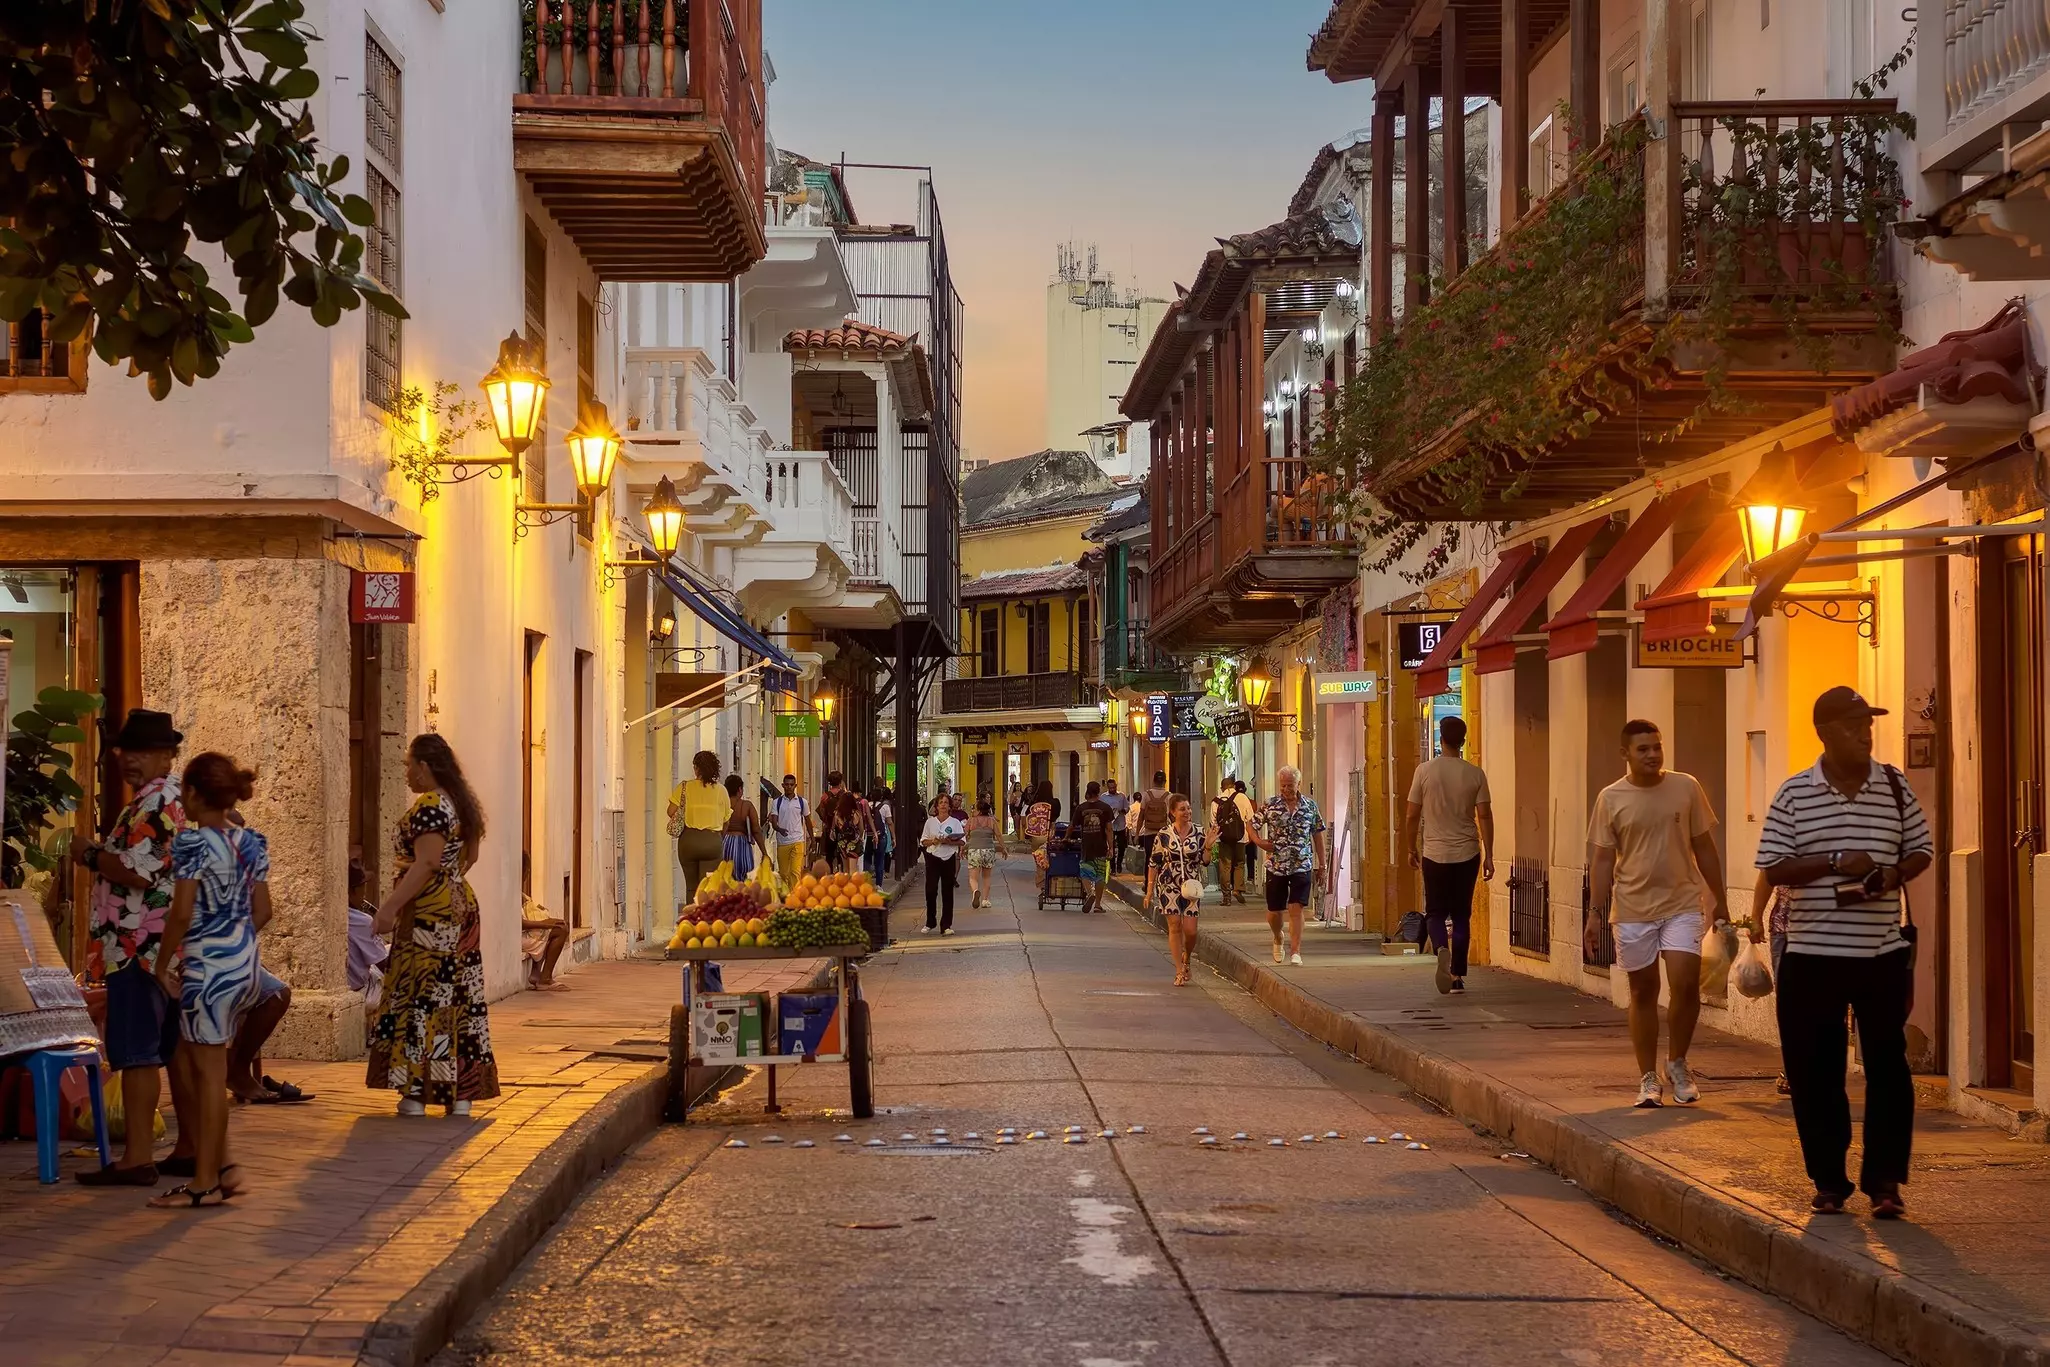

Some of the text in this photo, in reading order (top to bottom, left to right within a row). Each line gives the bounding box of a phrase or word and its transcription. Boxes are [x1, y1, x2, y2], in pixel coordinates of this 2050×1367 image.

[1647, 639, 1735, 652] BRIOCHE
[1319, 681, 1372, 695] SUBWAY
[788, 716, 806, 728] 24
[1153, 705, 1162, 736] BAR
[1216, 715, 1245, 729] Fashion
